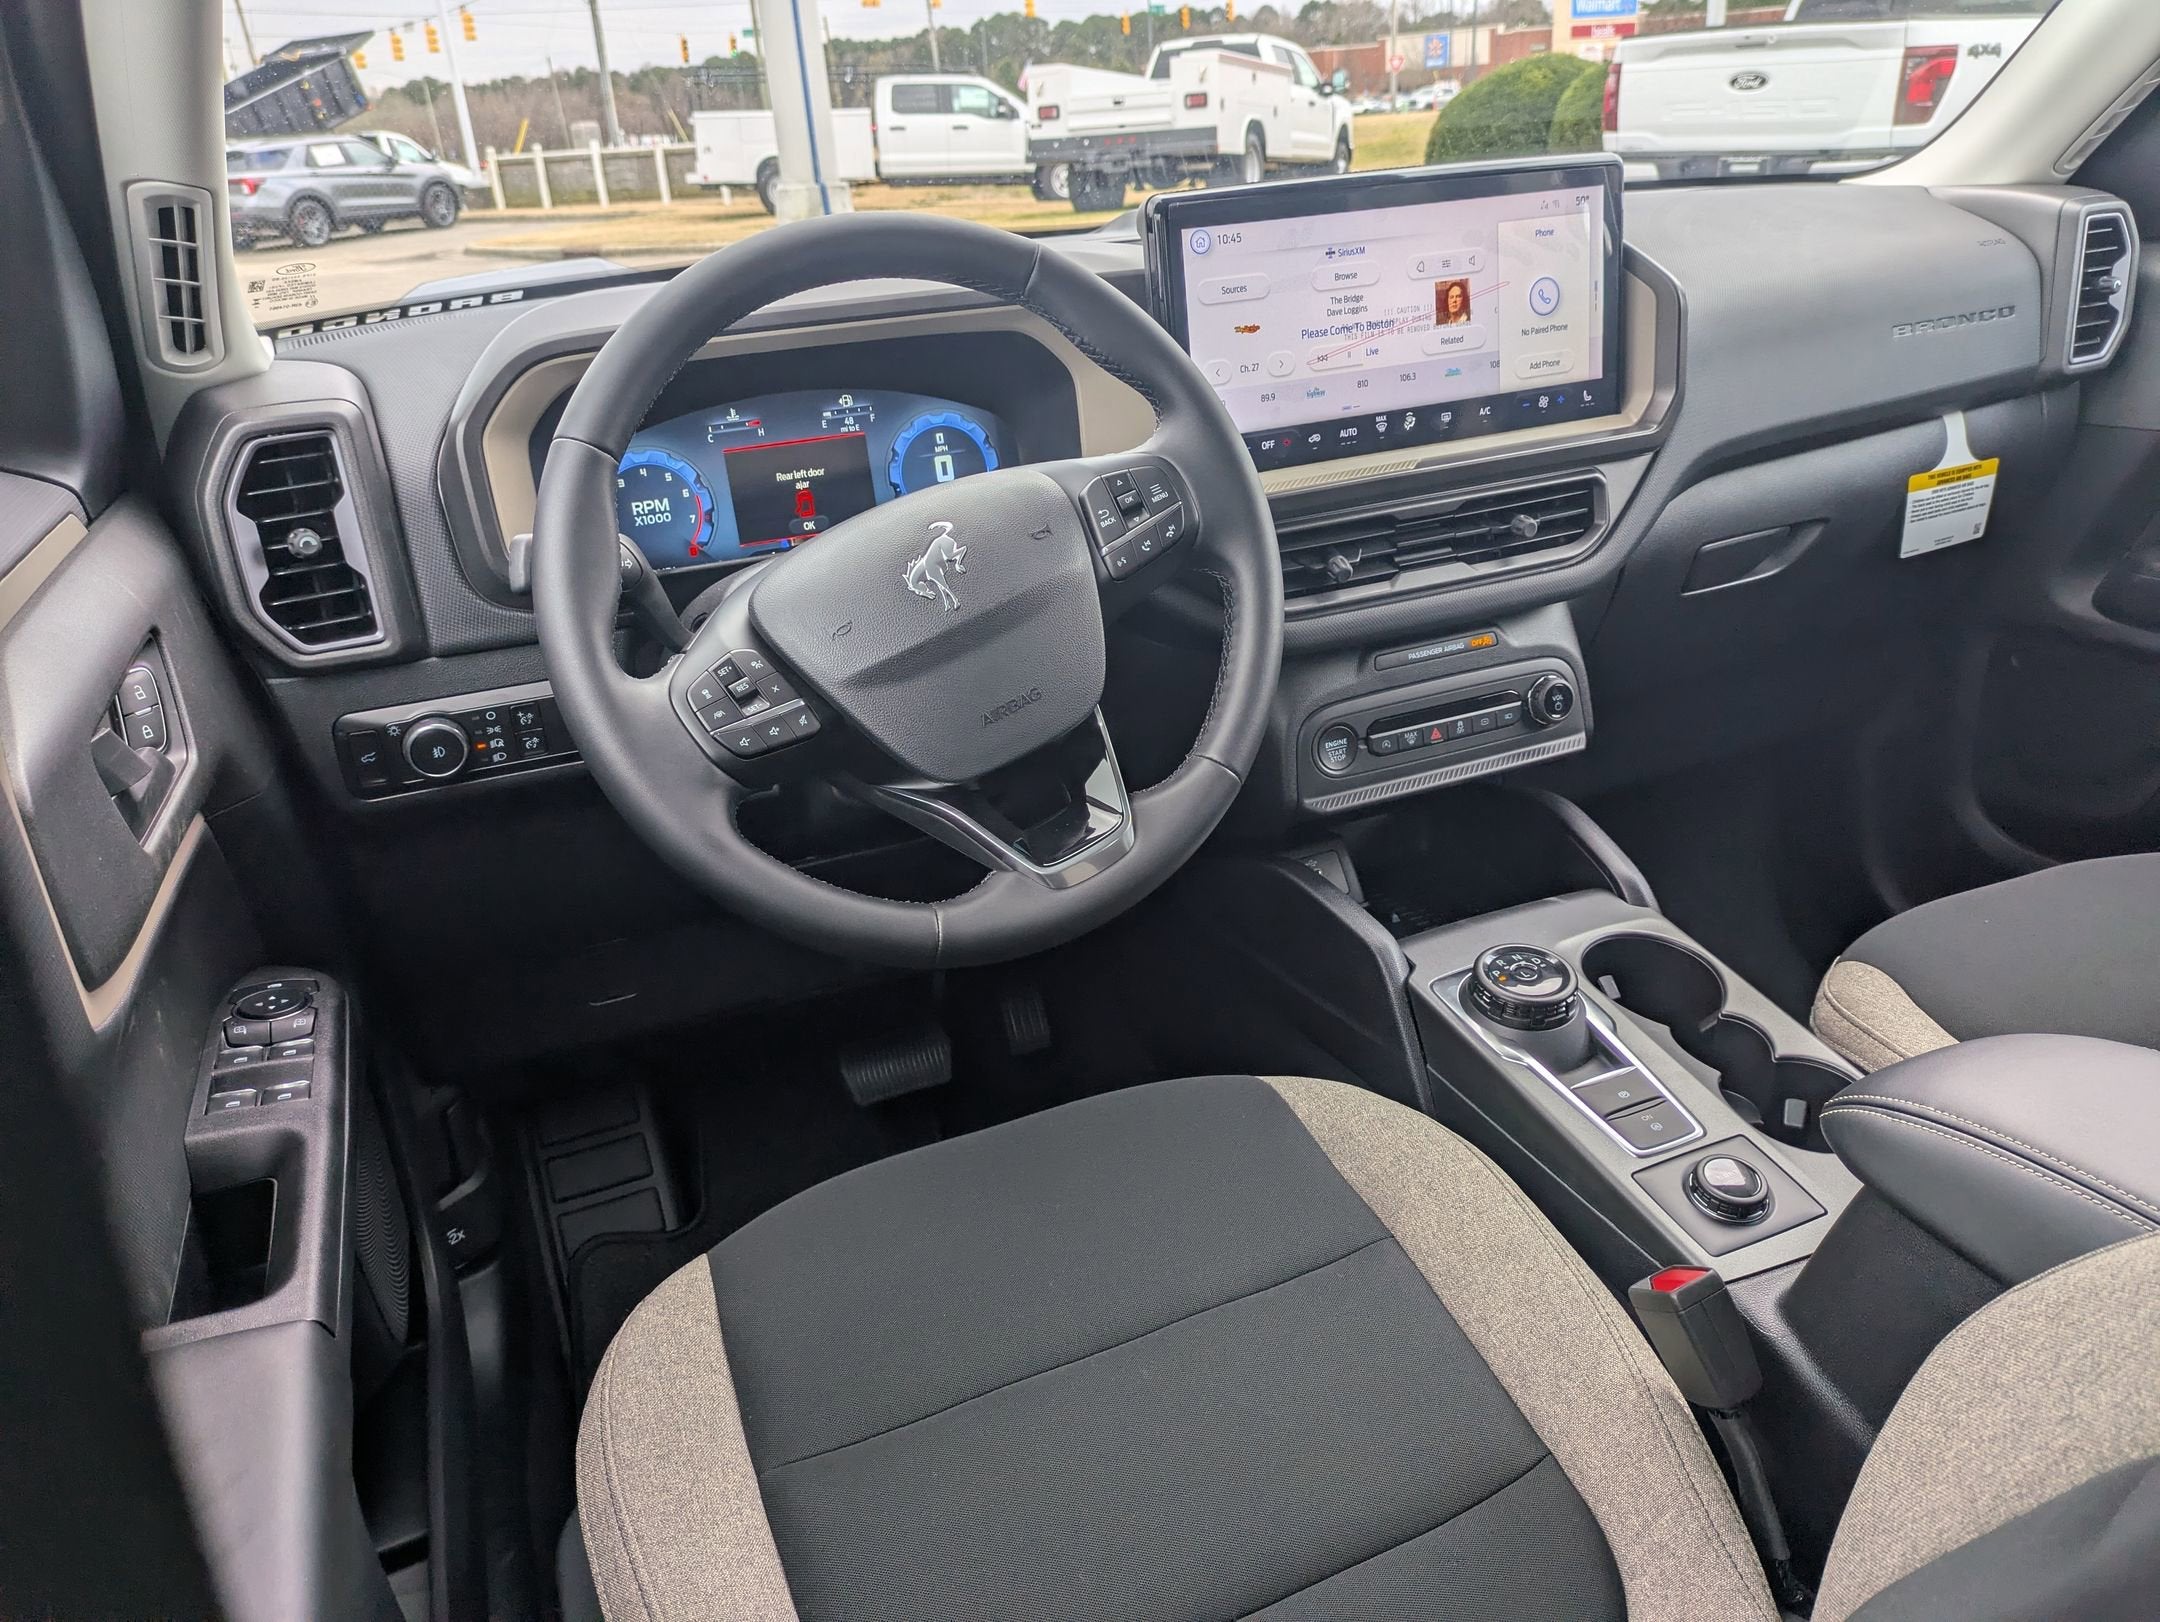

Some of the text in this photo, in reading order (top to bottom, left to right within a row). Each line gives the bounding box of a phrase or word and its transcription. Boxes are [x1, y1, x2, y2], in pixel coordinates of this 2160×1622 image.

[1735, 73, 1767, 89] Ford
[1535, 228, 1555, 237] Phone
[1217, 232, 1242, 245] 10:45
[1338, 246, 1366, 257] SiriusXM
[1334, 272, 1358, 281] Browse
[1221, 285, 1248, 295] Sources
[1330, 294, 1364, 305] The Bridge
[1326, 304, 1368, 317] Dave Loggins
[1397, 304, 1420, 314] CAUTION
[1892, 305, 2016, 338] BRONCO
[1301, 319, 1394, 340] Please Come To Boston
[1521, 323, 1569, 337] No Paired Phone
[1440, 335, 1464, 346] Related
[1366, 347, 1379, 356] Live
[1240, 363, 1260, 374] Ch. 27
[1530, 359, 1561, 371] Add Phone
[1399, 372, 1417, 383] 106.3
[1357, 379, 1369, 389] 810
[1260, 393, 1276, 403] 89.9
[1479, 406, 1491, 415] A/C
[870, 414, 876, 422] F
[821, 420, 828, 428] E
[758, 428, 765, 437] H
[1340, 427, 1358, 438] AUTO
[707, 434, 714, 443] C
[935, 432, 945, 444] 0
[934, 445, 948, 453] MPH
[1261, 440, 1275, 450] OFF
[639, 468, 647, 477] 4
[934, 454, 955, 483] 0
[665, 472, 672, 481] 5
[776, 467, 825, 482] Rear left door
[617, 479, 625, 488] 3
[795, 481, 810, 490] ajar
[682, 488, 689, 497] 6
[1151, 491, 1169, 503] MENU
[1125, 496, 1134, 504] OK
[631, 497, 670, 515] RPM
[689, 514, 696, 523] 7
[1100, 516, 1117, 528] BACK
[803, 520, 816, 531] OK
[1408, 642, 1465, 660] PASSENGER AIRBAG
[735, 683, 750, 692] RES
[1552, 694, 1564, 702] VOL
[980, 687, 1042, 728] AIRBAG
[1404, 731, 1418, 739] MAX
[1325, 737, 1348, 749] ENGINE
[1328, 748, 1347, 758] START
[1330, 754, 1347, 763] STOP
[1511, 953, 1523, 961] N
[1496, 959, 1507, 967] R
[1492, 969, 1501, 977] P
